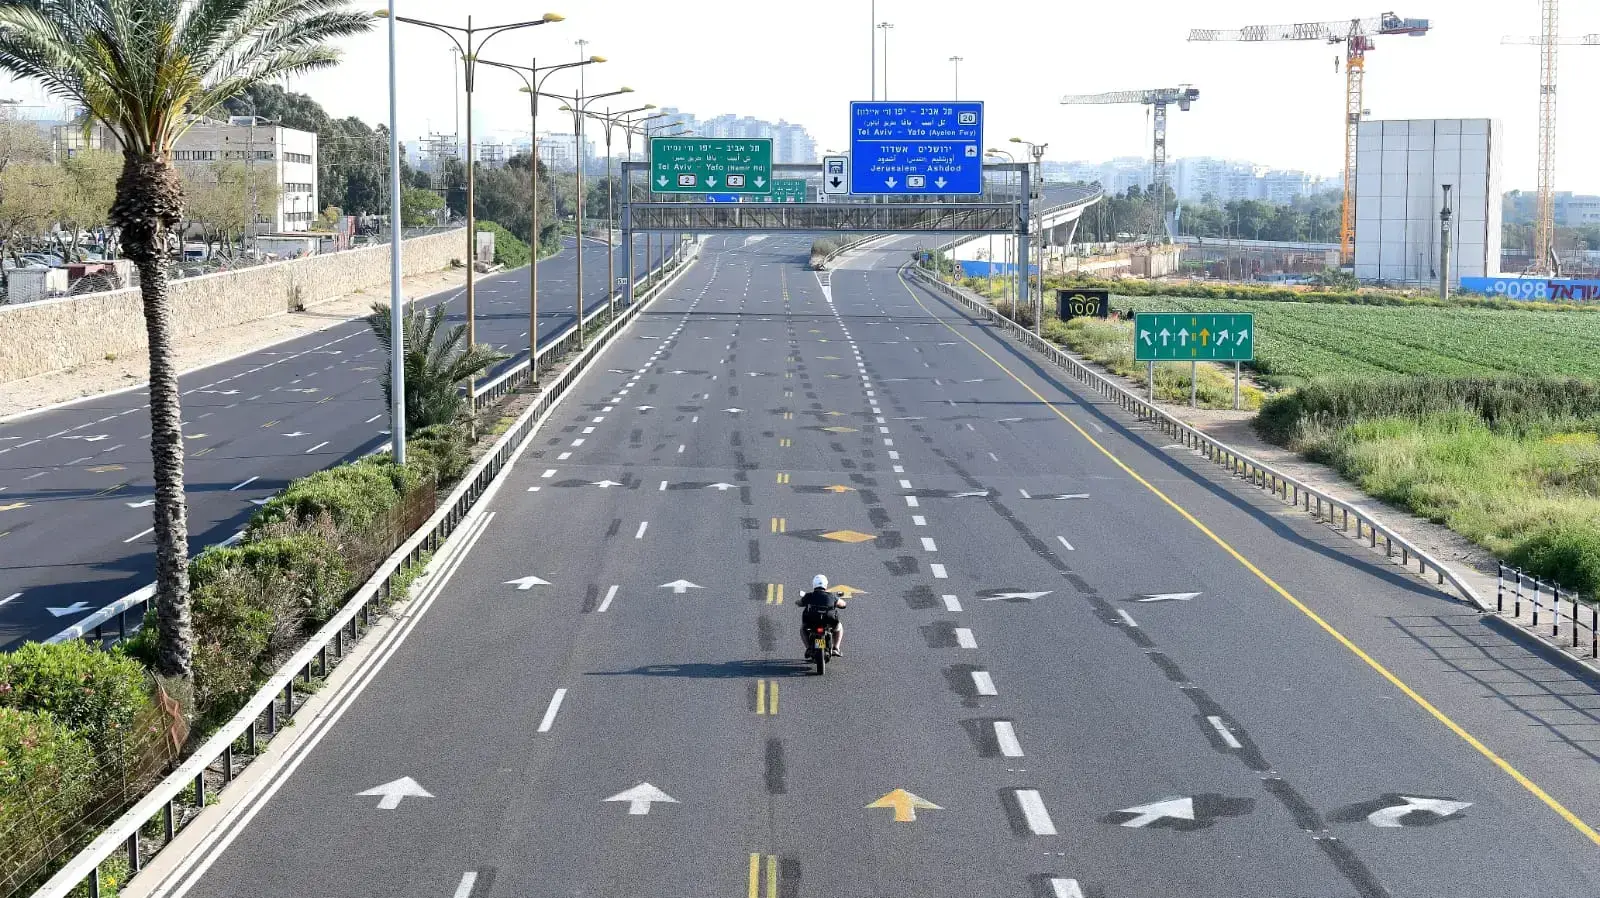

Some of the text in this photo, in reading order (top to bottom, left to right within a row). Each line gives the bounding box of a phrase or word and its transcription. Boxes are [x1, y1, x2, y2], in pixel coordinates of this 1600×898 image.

[942, 107, 952, 116] תל
[858, 128, 869, 136] Tel
[874, 128, 893, 136] Aviv
[907, 128, 926, 136] Yafo
[929, 129, 956, 137] (Ayalon
[960, 129, 976, 137] Fwy)
[699, 144, 711, 152] יפו
[749, 144, 760, 152] תל
[881, 145, 952, 153] ירושלים אשדוד
[706, 163, 724, 171] Yafo
